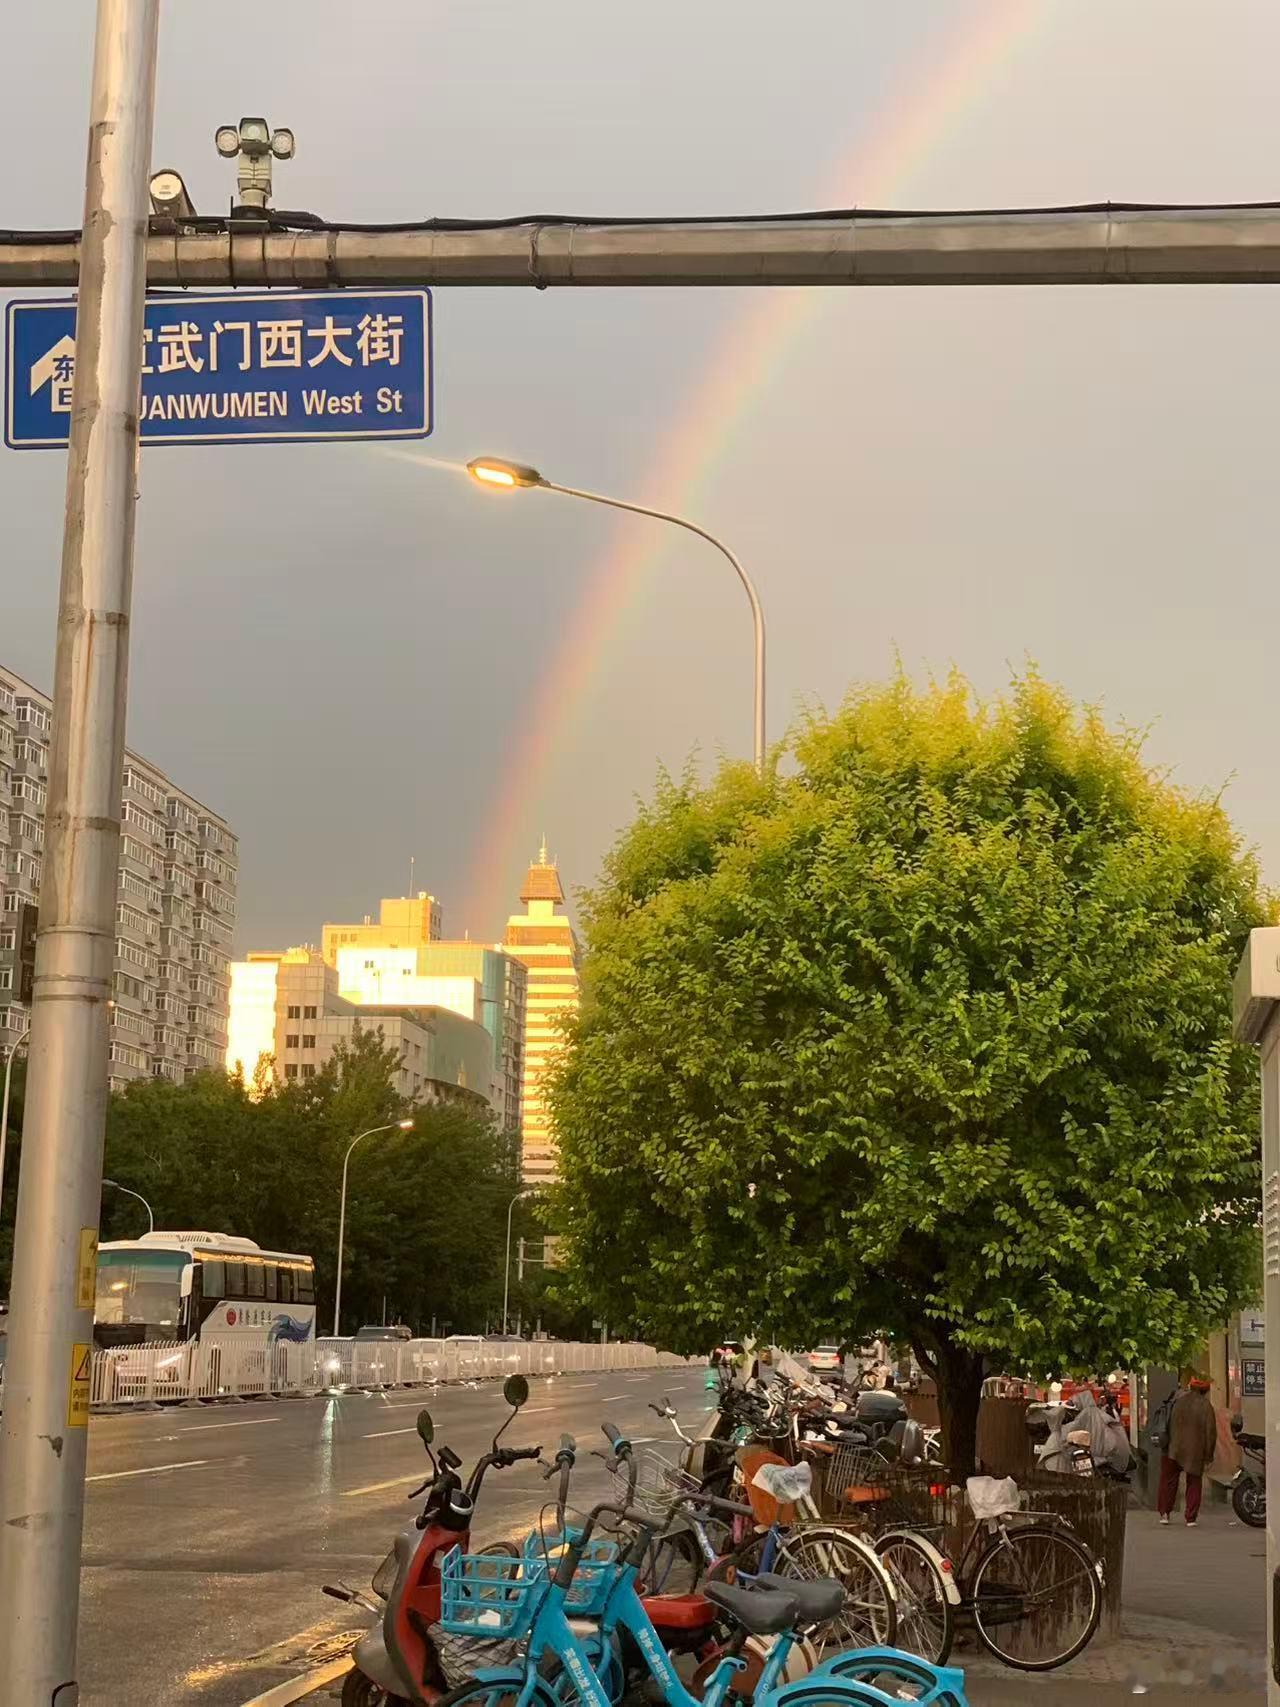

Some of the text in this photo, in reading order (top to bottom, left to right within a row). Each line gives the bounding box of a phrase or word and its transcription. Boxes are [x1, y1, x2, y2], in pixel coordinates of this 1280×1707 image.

[53, 355, 75, 382] 东
[302, 389, 363, 415] West
[376, 387, 403, 413] St
